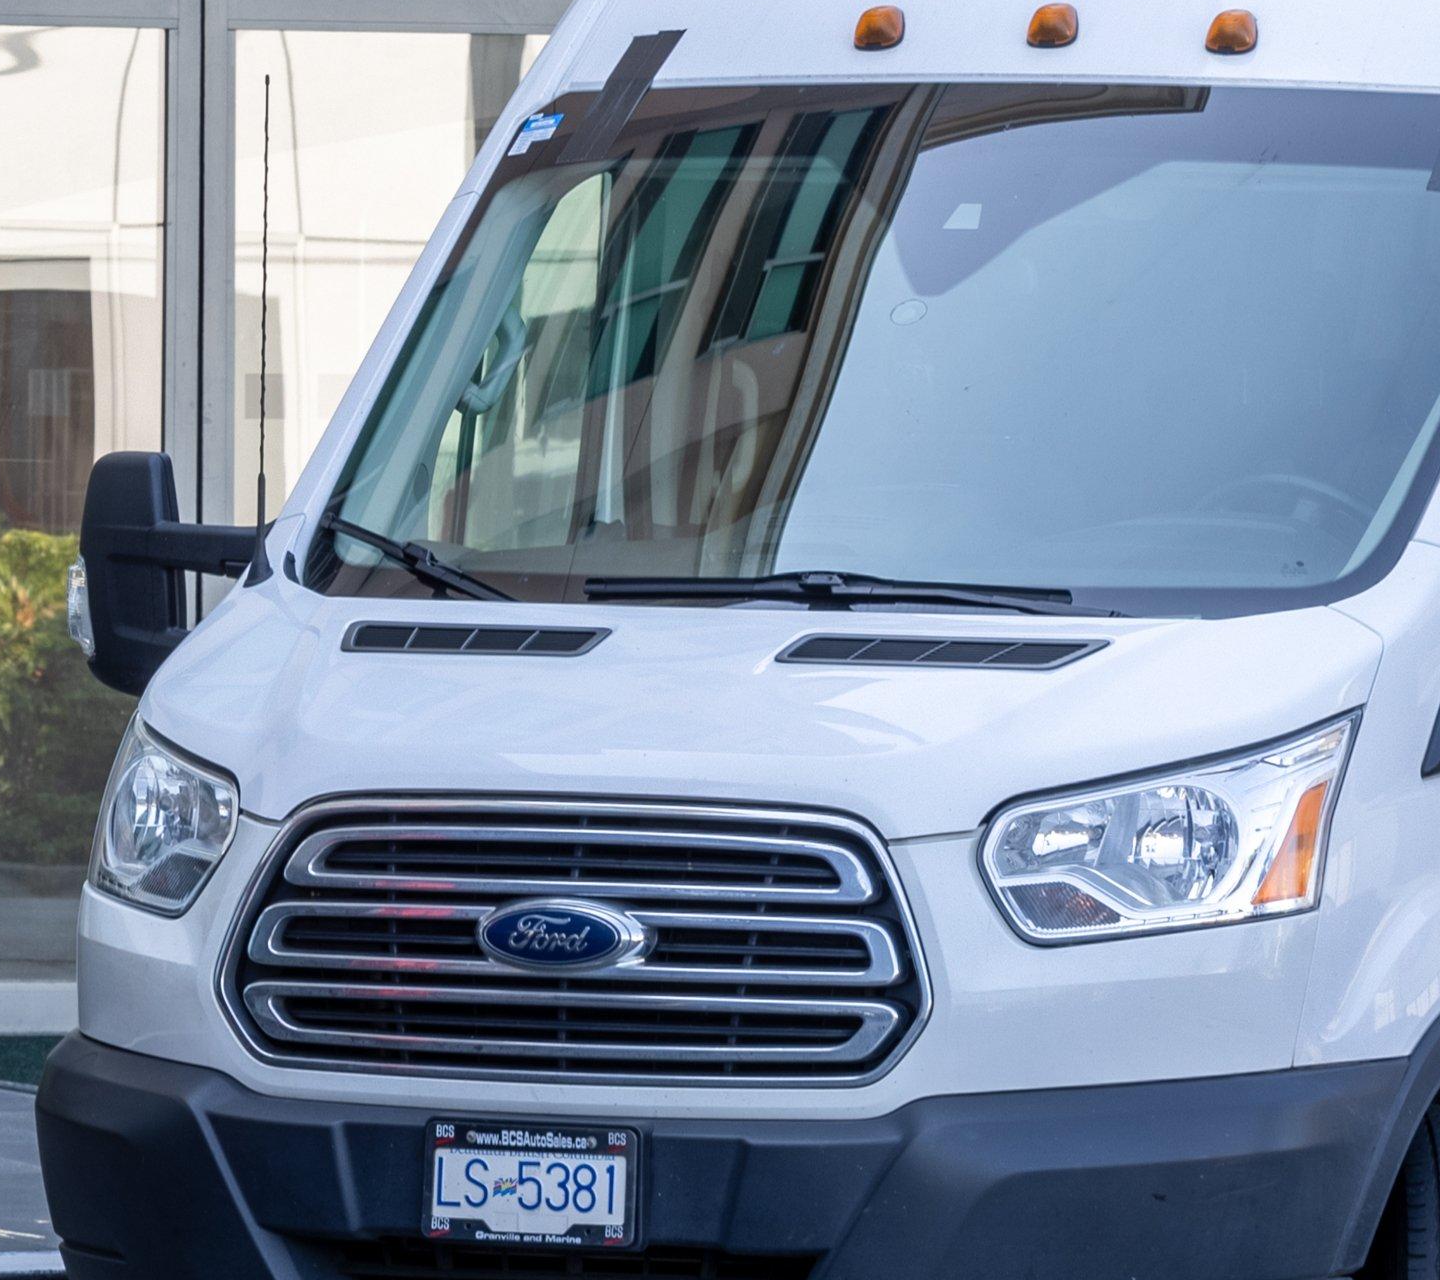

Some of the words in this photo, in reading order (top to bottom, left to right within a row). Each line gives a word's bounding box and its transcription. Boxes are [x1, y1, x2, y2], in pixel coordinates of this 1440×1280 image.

[508, 914, 591, 952] Ford
[436, 1124, 455, 1138] BCS
[476, 1130, 587, 1149] www.BCSAutoSales.ca
[608, 1132, 627, 1146] BCS
[437, 1157, 489, 1207] LS
[518, 1161, 615, 1215] 5381
[431, 1217, 450, 1230] BCS
[475, 1230, 520, 1242] Granville
[523, 1233, 542, 1243] and
[546, 1234, 581, 1245] Marine
[605, 1224, 624, 1239] BCS
